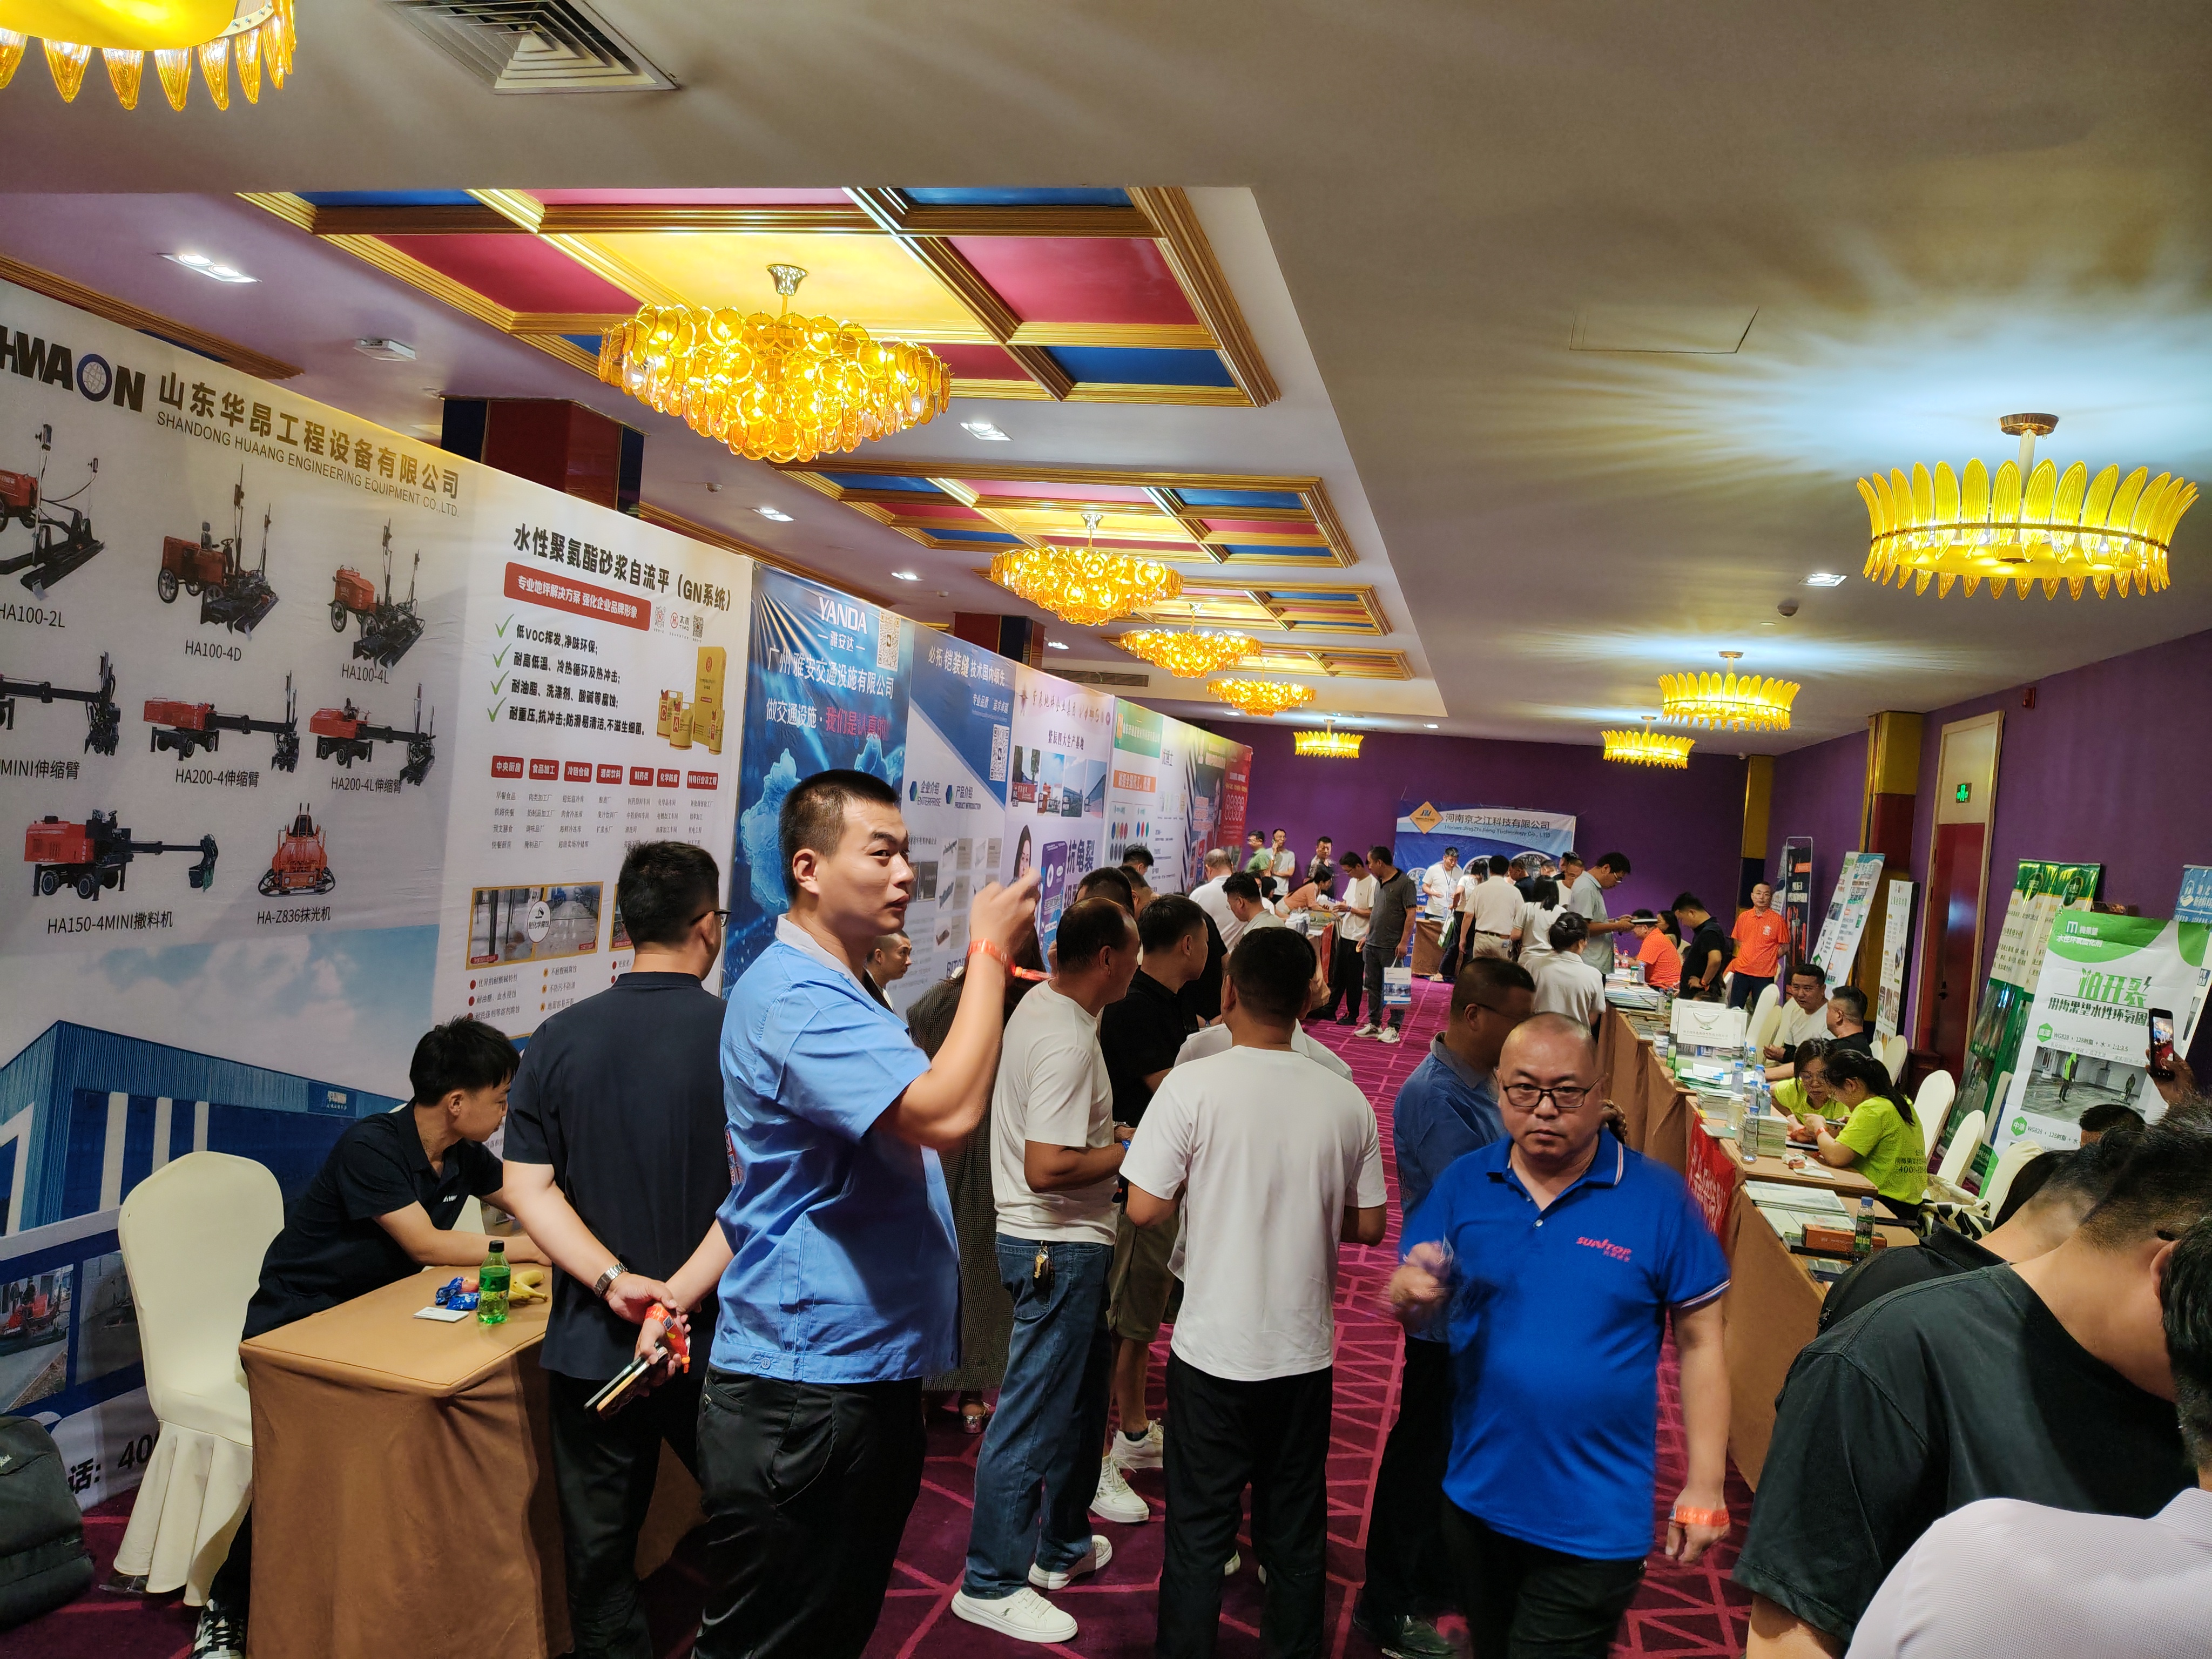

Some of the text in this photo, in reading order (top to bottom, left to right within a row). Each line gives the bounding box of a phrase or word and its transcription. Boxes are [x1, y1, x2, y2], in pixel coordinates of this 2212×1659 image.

[158, 371, 460, 500] 山东华昂工程设备有限公司
[157, 411, 231, 447] SHANDONG
[234, 436, 285, 463] HUAANG
[288, 453, 362, 488] ENGINEERING
[365, 477, 421, 505] EQUIPMENT
[517, 575, 638, 620] 专业地坪解决方案 强化企业品牌形象
[818, 596, 868, 635] YANDA
[185, 640, 242, 662] HA100-4D
[341, 663, 389, 685] HA100-4L
[767, 644, 895, 700] 广州雅安交通设施有限公司
[970, 659, 1006, 687] 技术国内领先
[175, 768, 260, 788] HA200-4伸缩臂
[496, 761, 522, 773] 中央厨房
[532, 763, 556, 774] 食品加工
[567, 766, 590, 777] 冷链仓储
[331, 777, 402, 794] HA200-4L伸缩臂
[1445, 812, 1550, 831] 河南京之江科技有限公司
[47, 911, 173, 935] HA150-4MINI撒料机
[257, 906, 332, 925] HA-Z836抹光机
[2047, 997, 2150, 1027] 用梅果望水性环氧固
[117, 1433, 159, 1469] 40
